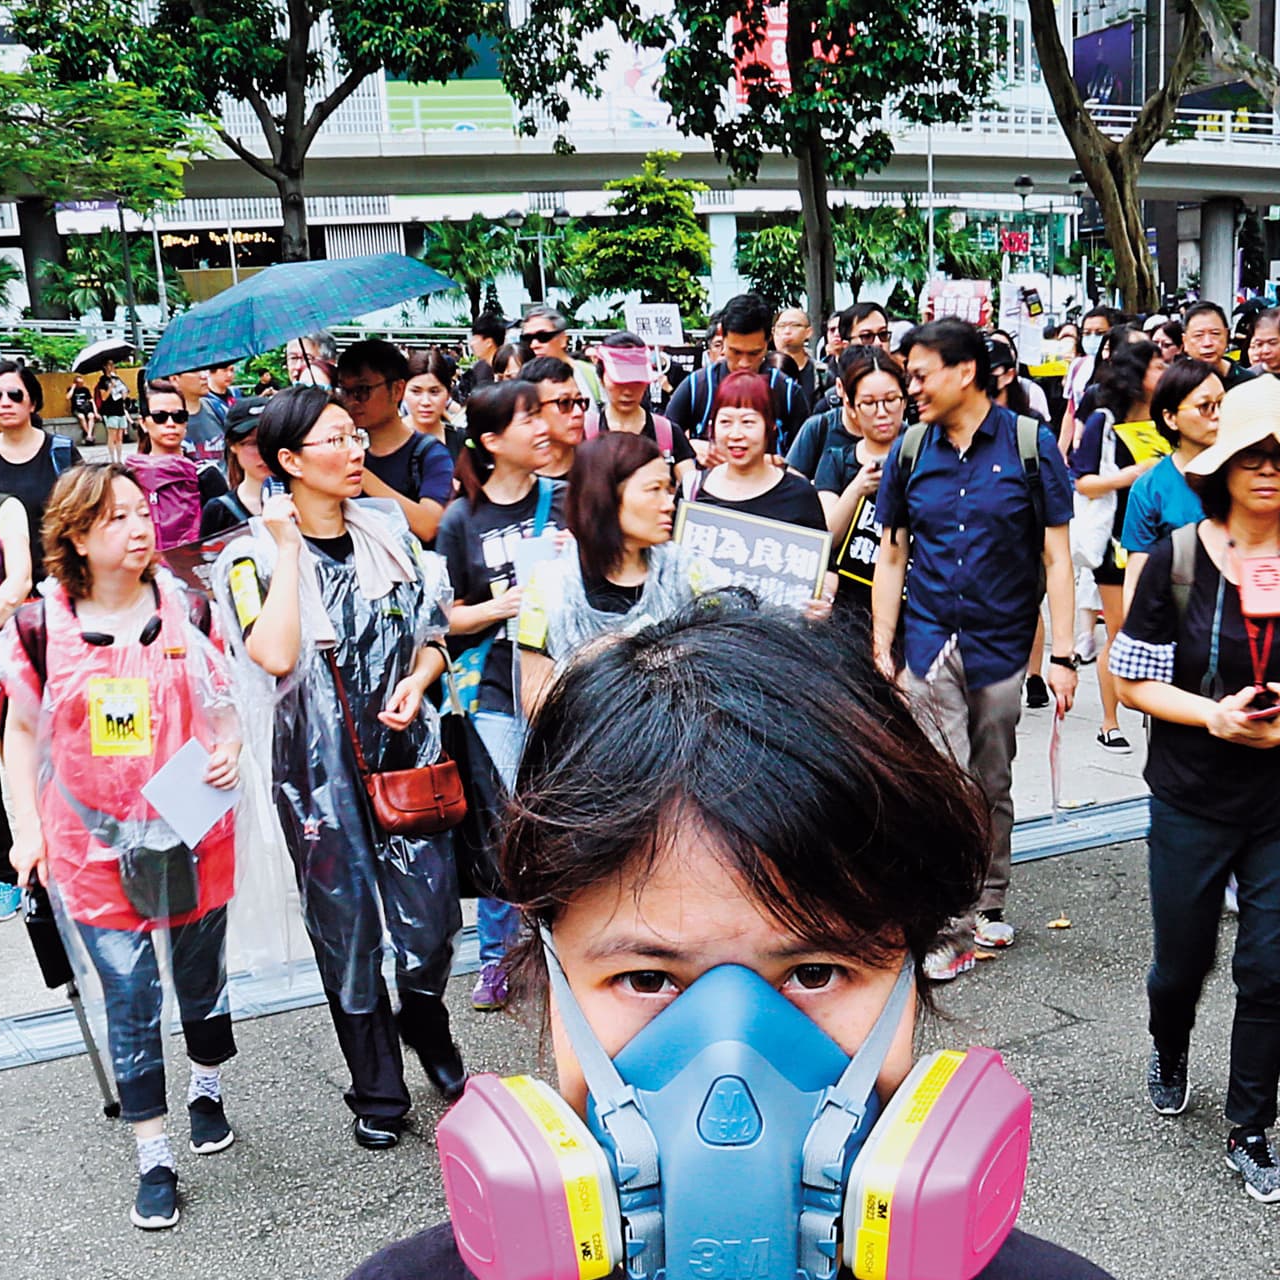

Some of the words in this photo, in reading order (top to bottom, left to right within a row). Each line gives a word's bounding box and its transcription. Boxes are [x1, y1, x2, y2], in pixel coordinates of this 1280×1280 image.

[877, 1200, 888, 1219] 3M
[580, 1241, 593, 1261] 3M
[688, 1237, 770, 1280] 3M
